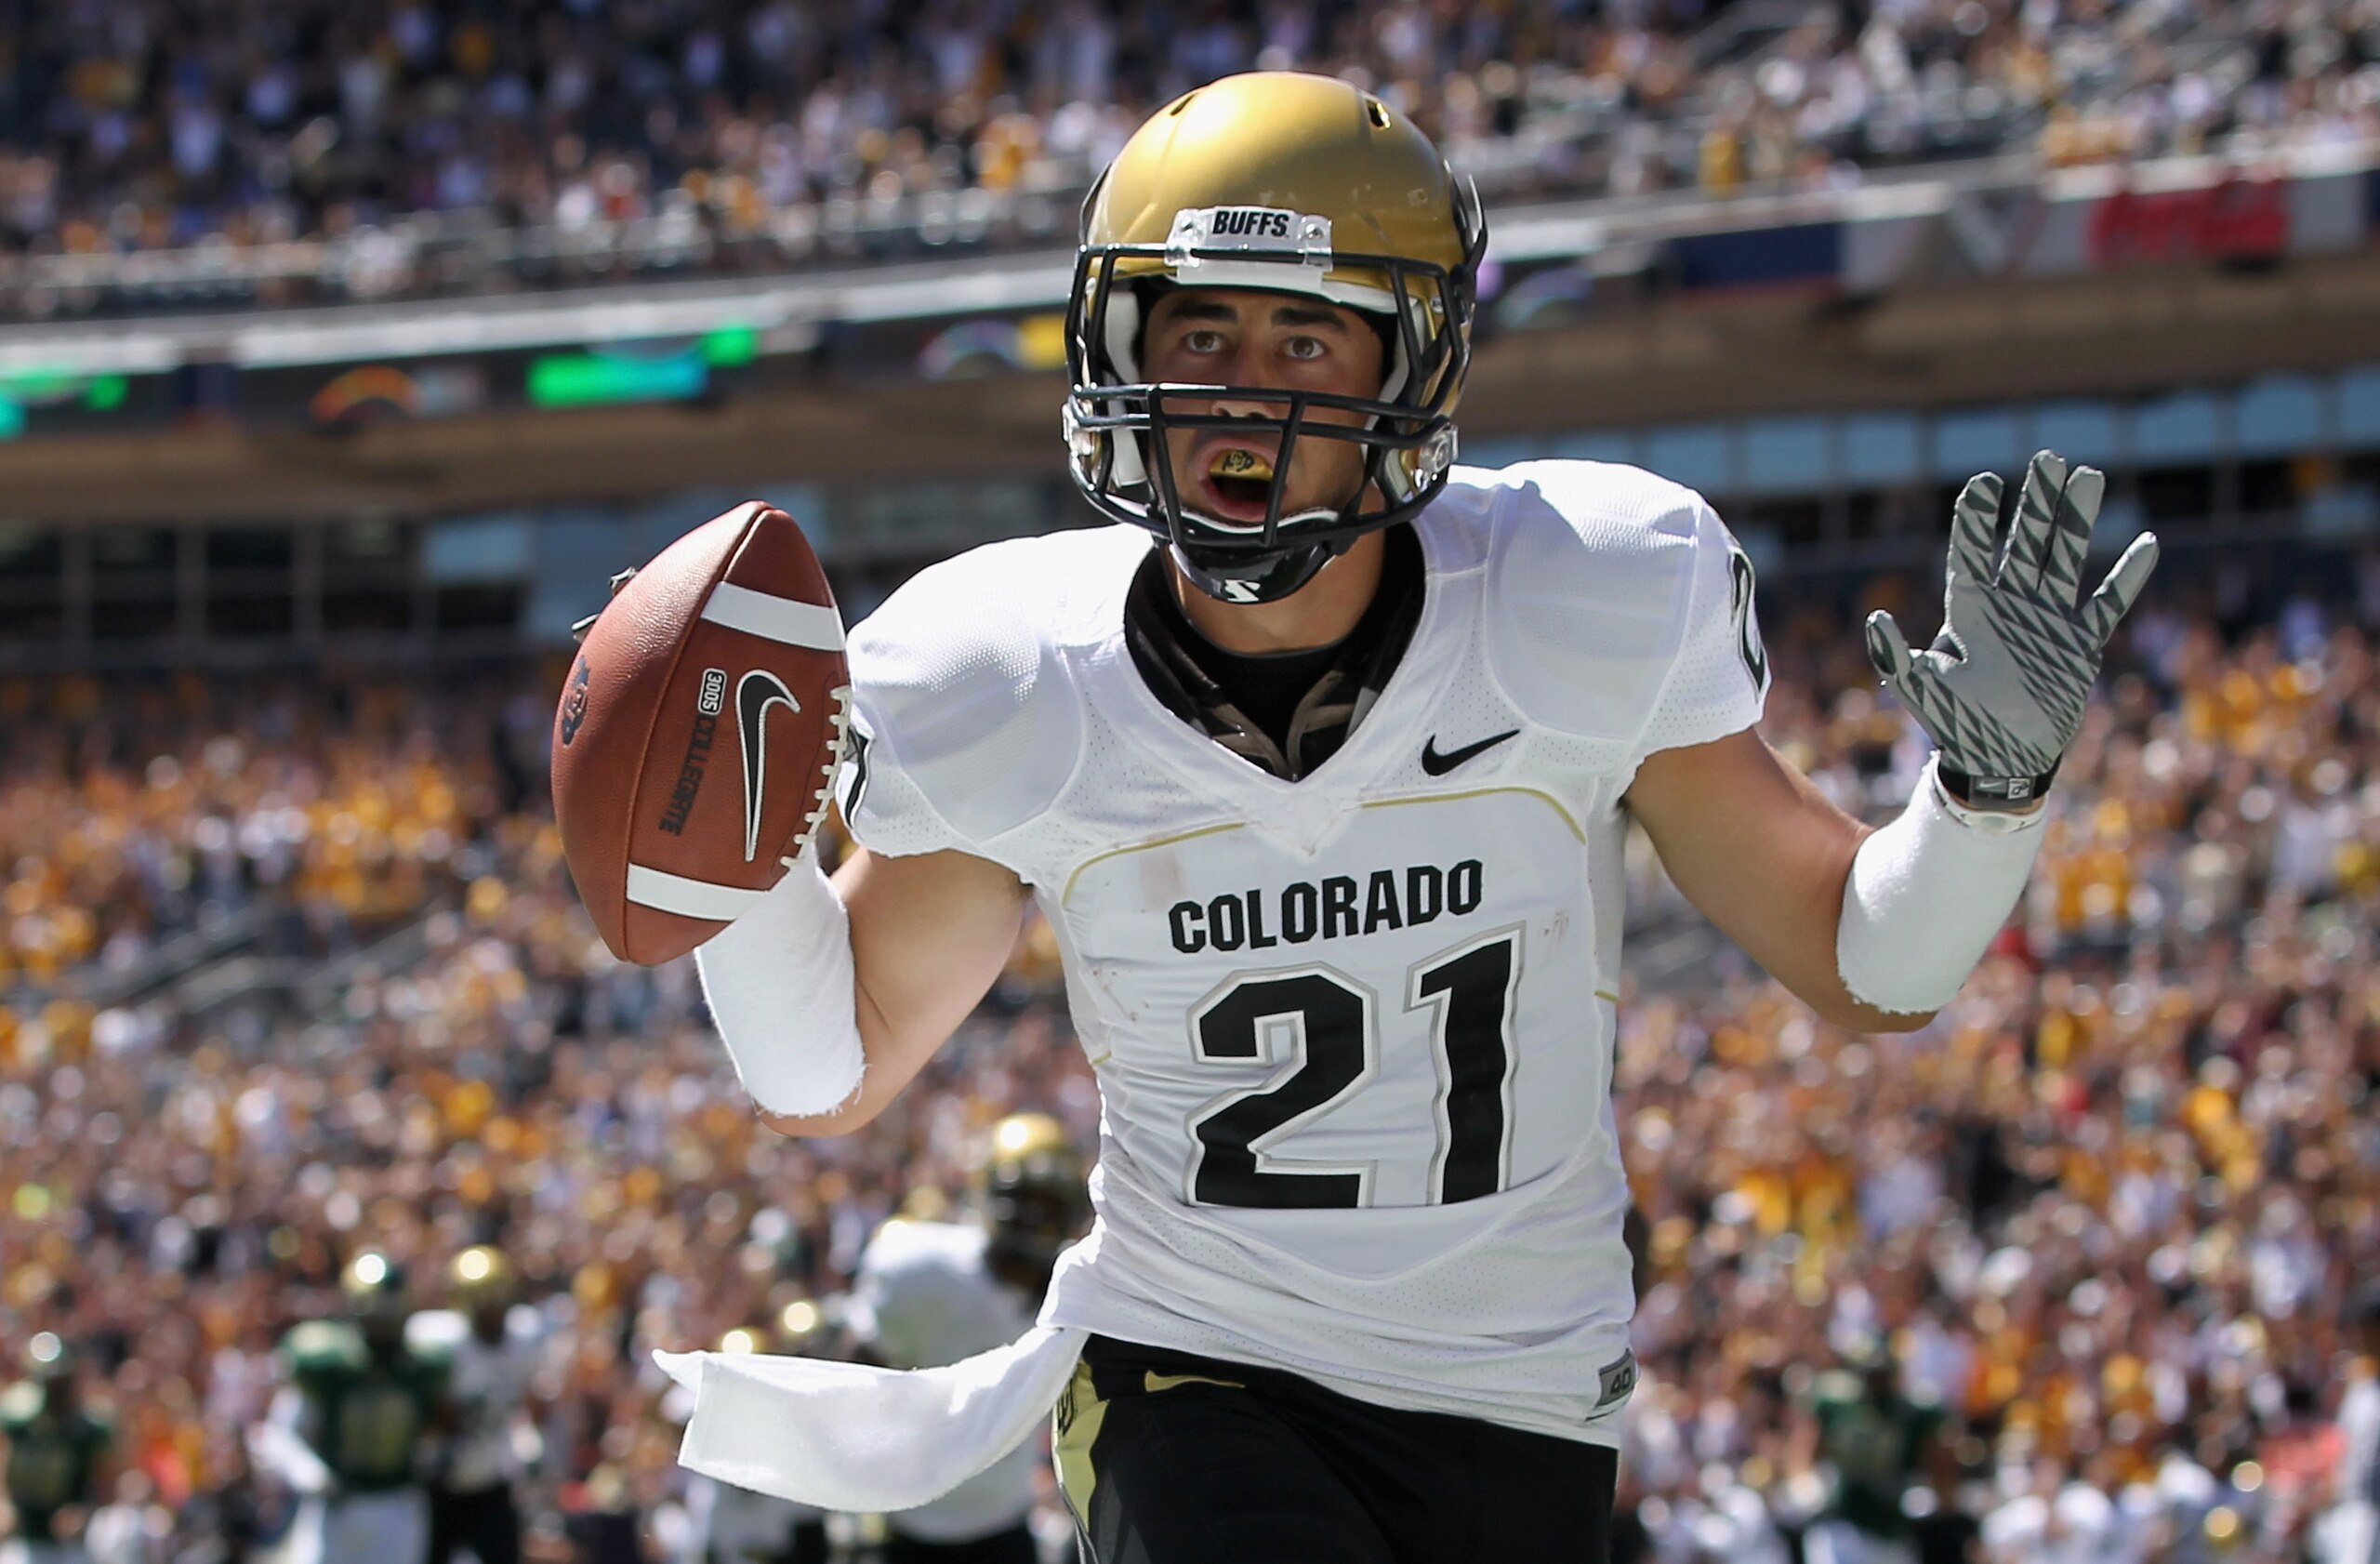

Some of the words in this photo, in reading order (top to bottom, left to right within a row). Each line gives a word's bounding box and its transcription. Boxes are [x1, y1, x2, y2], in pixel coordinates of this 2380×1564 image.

[1212, 210, 1289, 237] BUFFS
[658, 713, 717, 835] COLLEGIATE
[1169, 858, 1482, 953] COLORADO
[1184, 922, 1525, 1208] 21
[1610, 1366, 1632, 1394] 40
